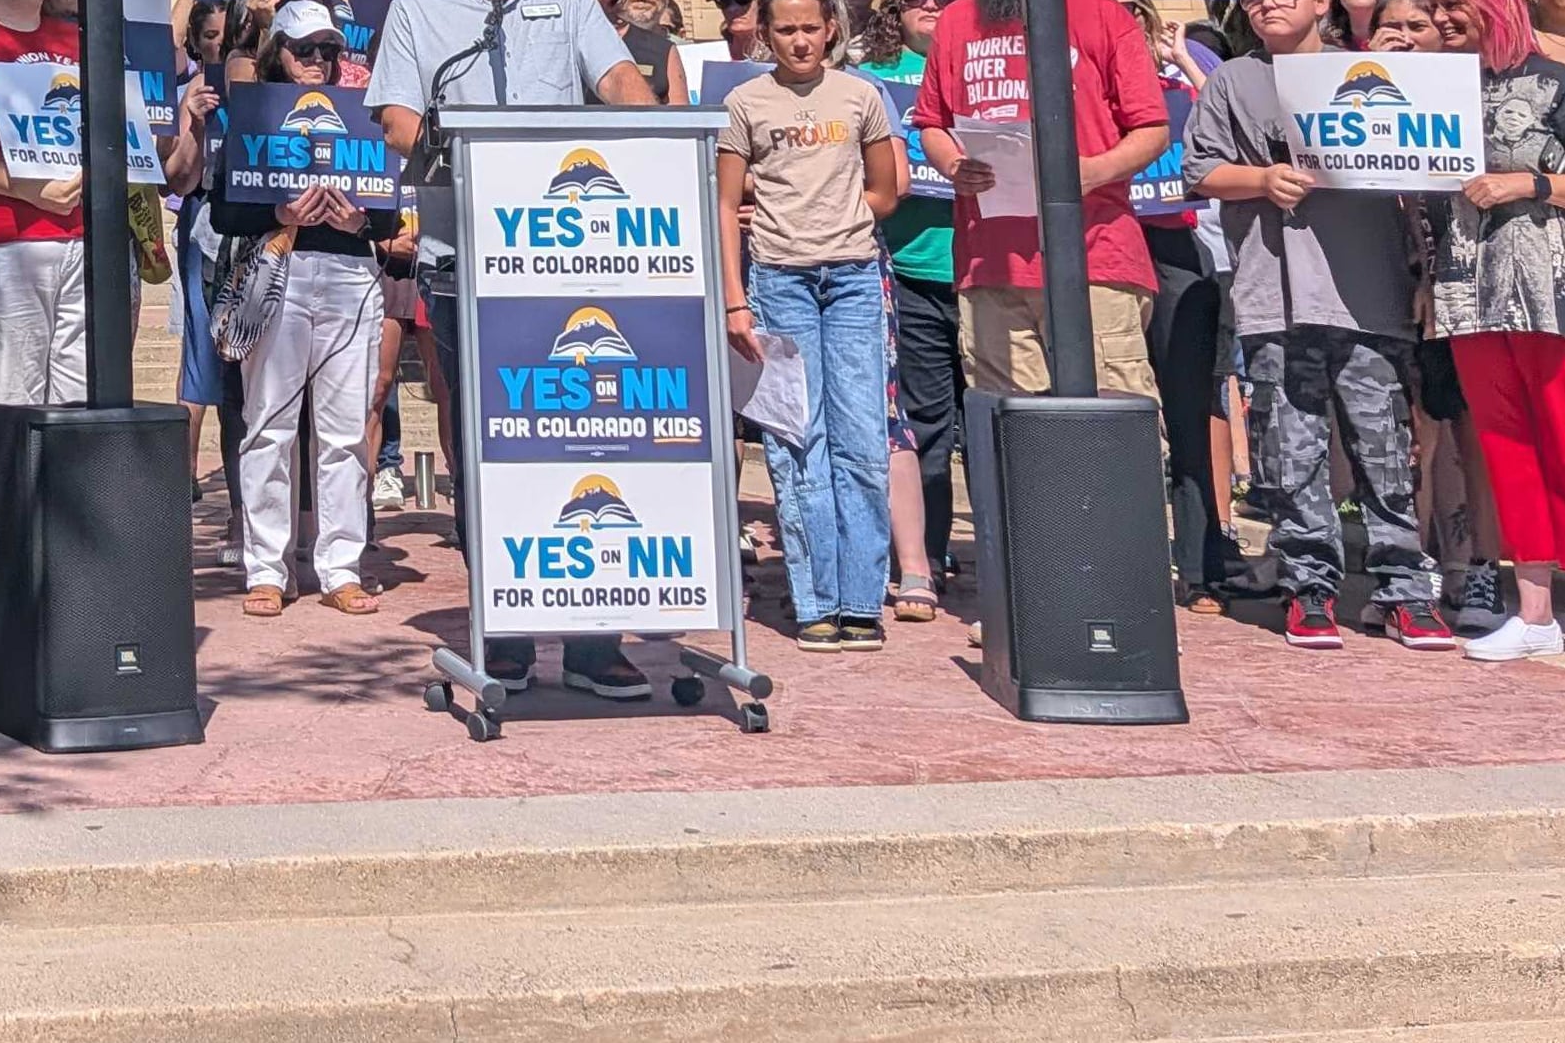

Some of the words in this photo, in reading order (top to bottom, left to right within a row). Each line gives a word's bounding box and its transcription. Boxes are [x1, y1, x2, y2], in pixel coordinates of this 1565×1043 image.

[966, 35, 1026, 60] WORKE
[964, 58, 1006, 83] OVER
[143, 71, 164, 101] N
[966, 79, 1029, 106] BILLION
[8, 114, 75, 147] YES
[770, 120, 849, 151] PROUD
[1294, 111, 1367, 147] YES
[1372, 123, 1391, 135] ON
[1397, 113, 1461, 149] NN
[9, 148, 38, 163] FOR
[242, 134, 310, 169] YES
[315, 147, 331, 159] ON
[334, 138, 385, 172] NN
[1297, 154, 1320, 170] FOR
[1324, 154, 1420, 171] COLORADO
[1428, 156, 1475, 172] KIDS
[232, 171, 263, 187] FOR
[357, 177, 394, 193] KIDS
[494, 207, 585, 248] YES
[590, 220, 610, 234] ON
[616, 207, 680, 247] NN
[485, 256, 525, 274] FOR
[533, 255, 639, 274] COLORADO
[648, 256, 694, 273] KIDS
[497, 367, 592, 411] YES
[595, 381, 617, 396] ON
[621, 367, 688, 411] NN
[489, 417, 531, 438] FOR
[536, 417, 647, 438] COLORADO
[653, 417, 702, 437] KIDS
[502, 536, 595, 579] YES
[601, 550, 621, 563] ON
[628, 536, 692, 577] NN
[493, 588, 534, 607] FOR
[542, 587, 650, 607] COLORADO
[659, 587, 707, 606] KIDS
